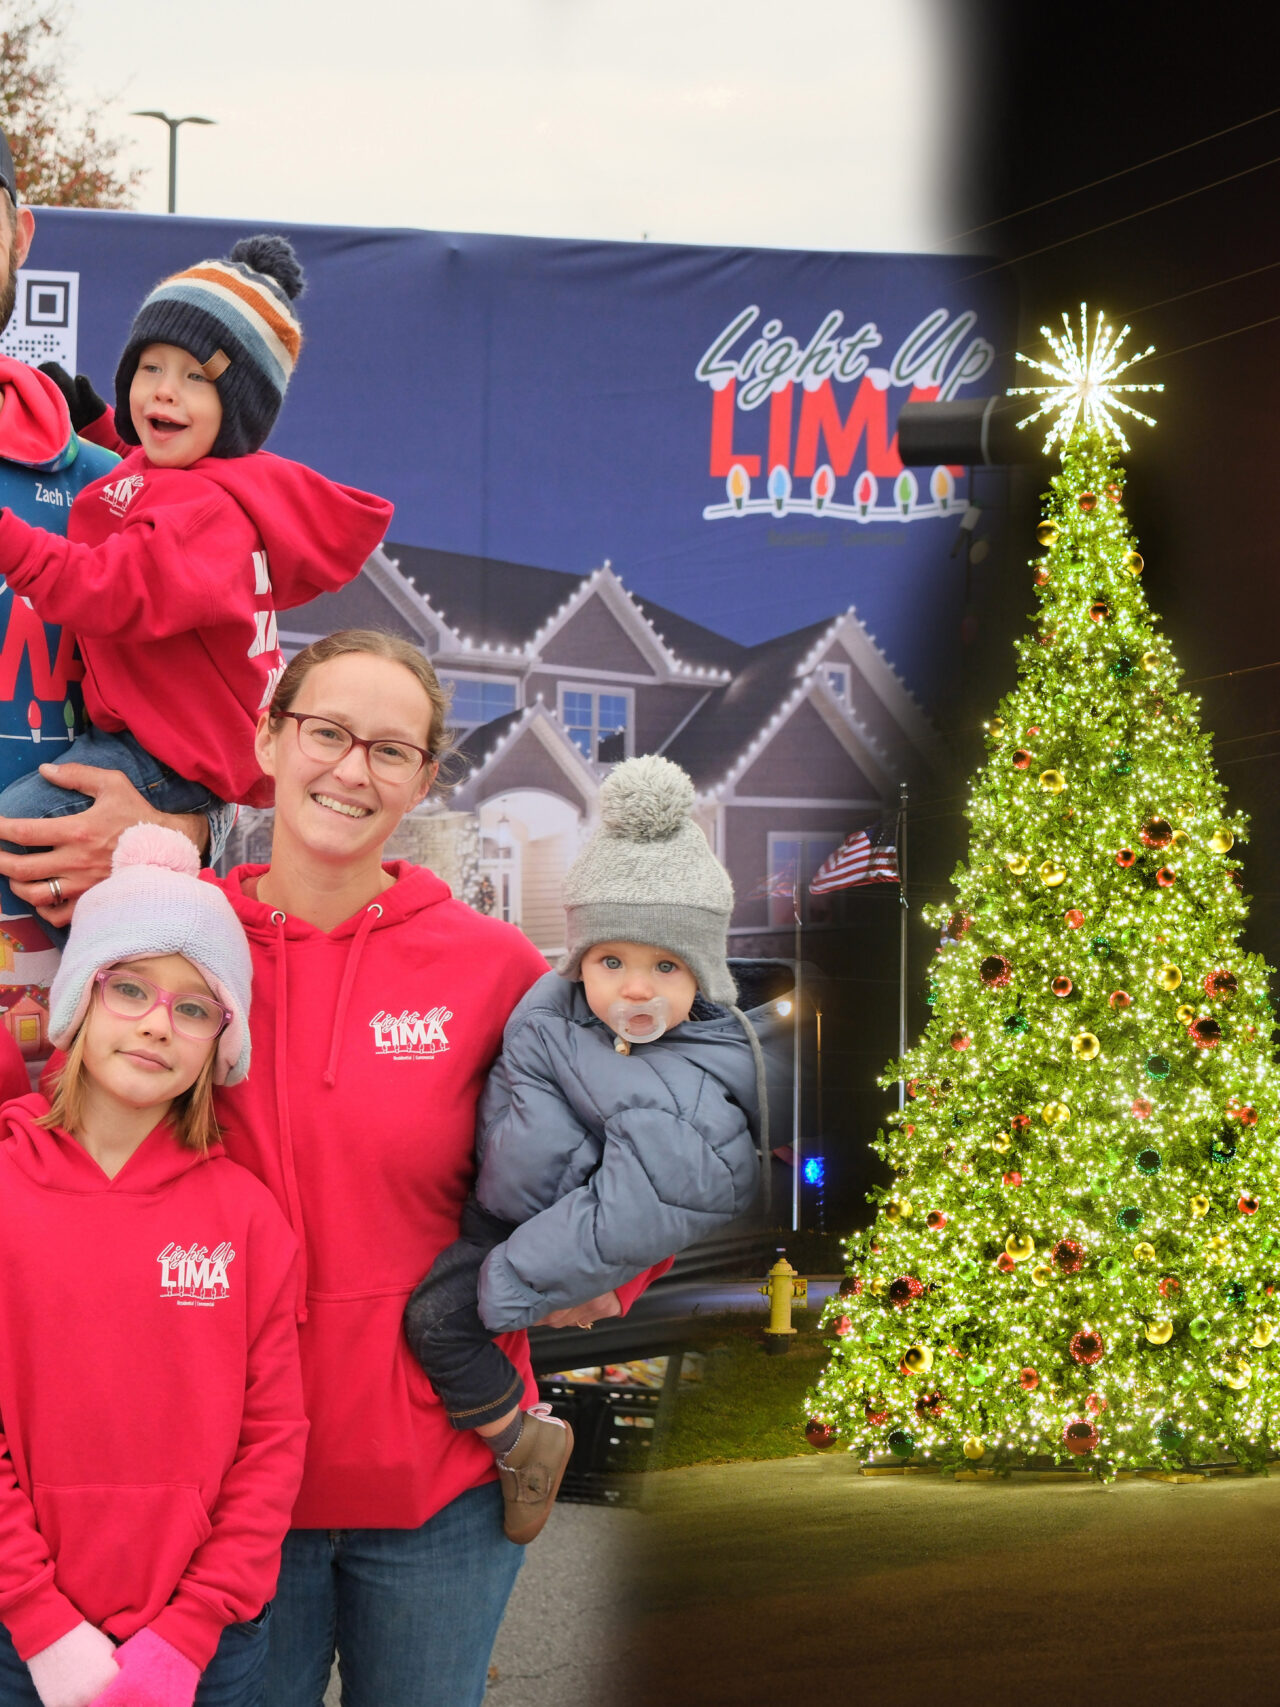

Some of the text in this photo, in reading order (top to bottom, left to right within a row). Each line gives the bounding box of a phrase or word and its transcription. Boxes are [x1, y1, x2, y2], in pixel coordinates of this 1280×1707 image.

[695, 304, 996, 411] Light Up
[35, 482, 63, 506] Zach
[369, 1006, 453, 1033] Light Up
[374, 1019, 449, 1047] LIMA
[156, 1242, 236, 1270] Light Up
[161, 1258, 230, 1289] LIMA
